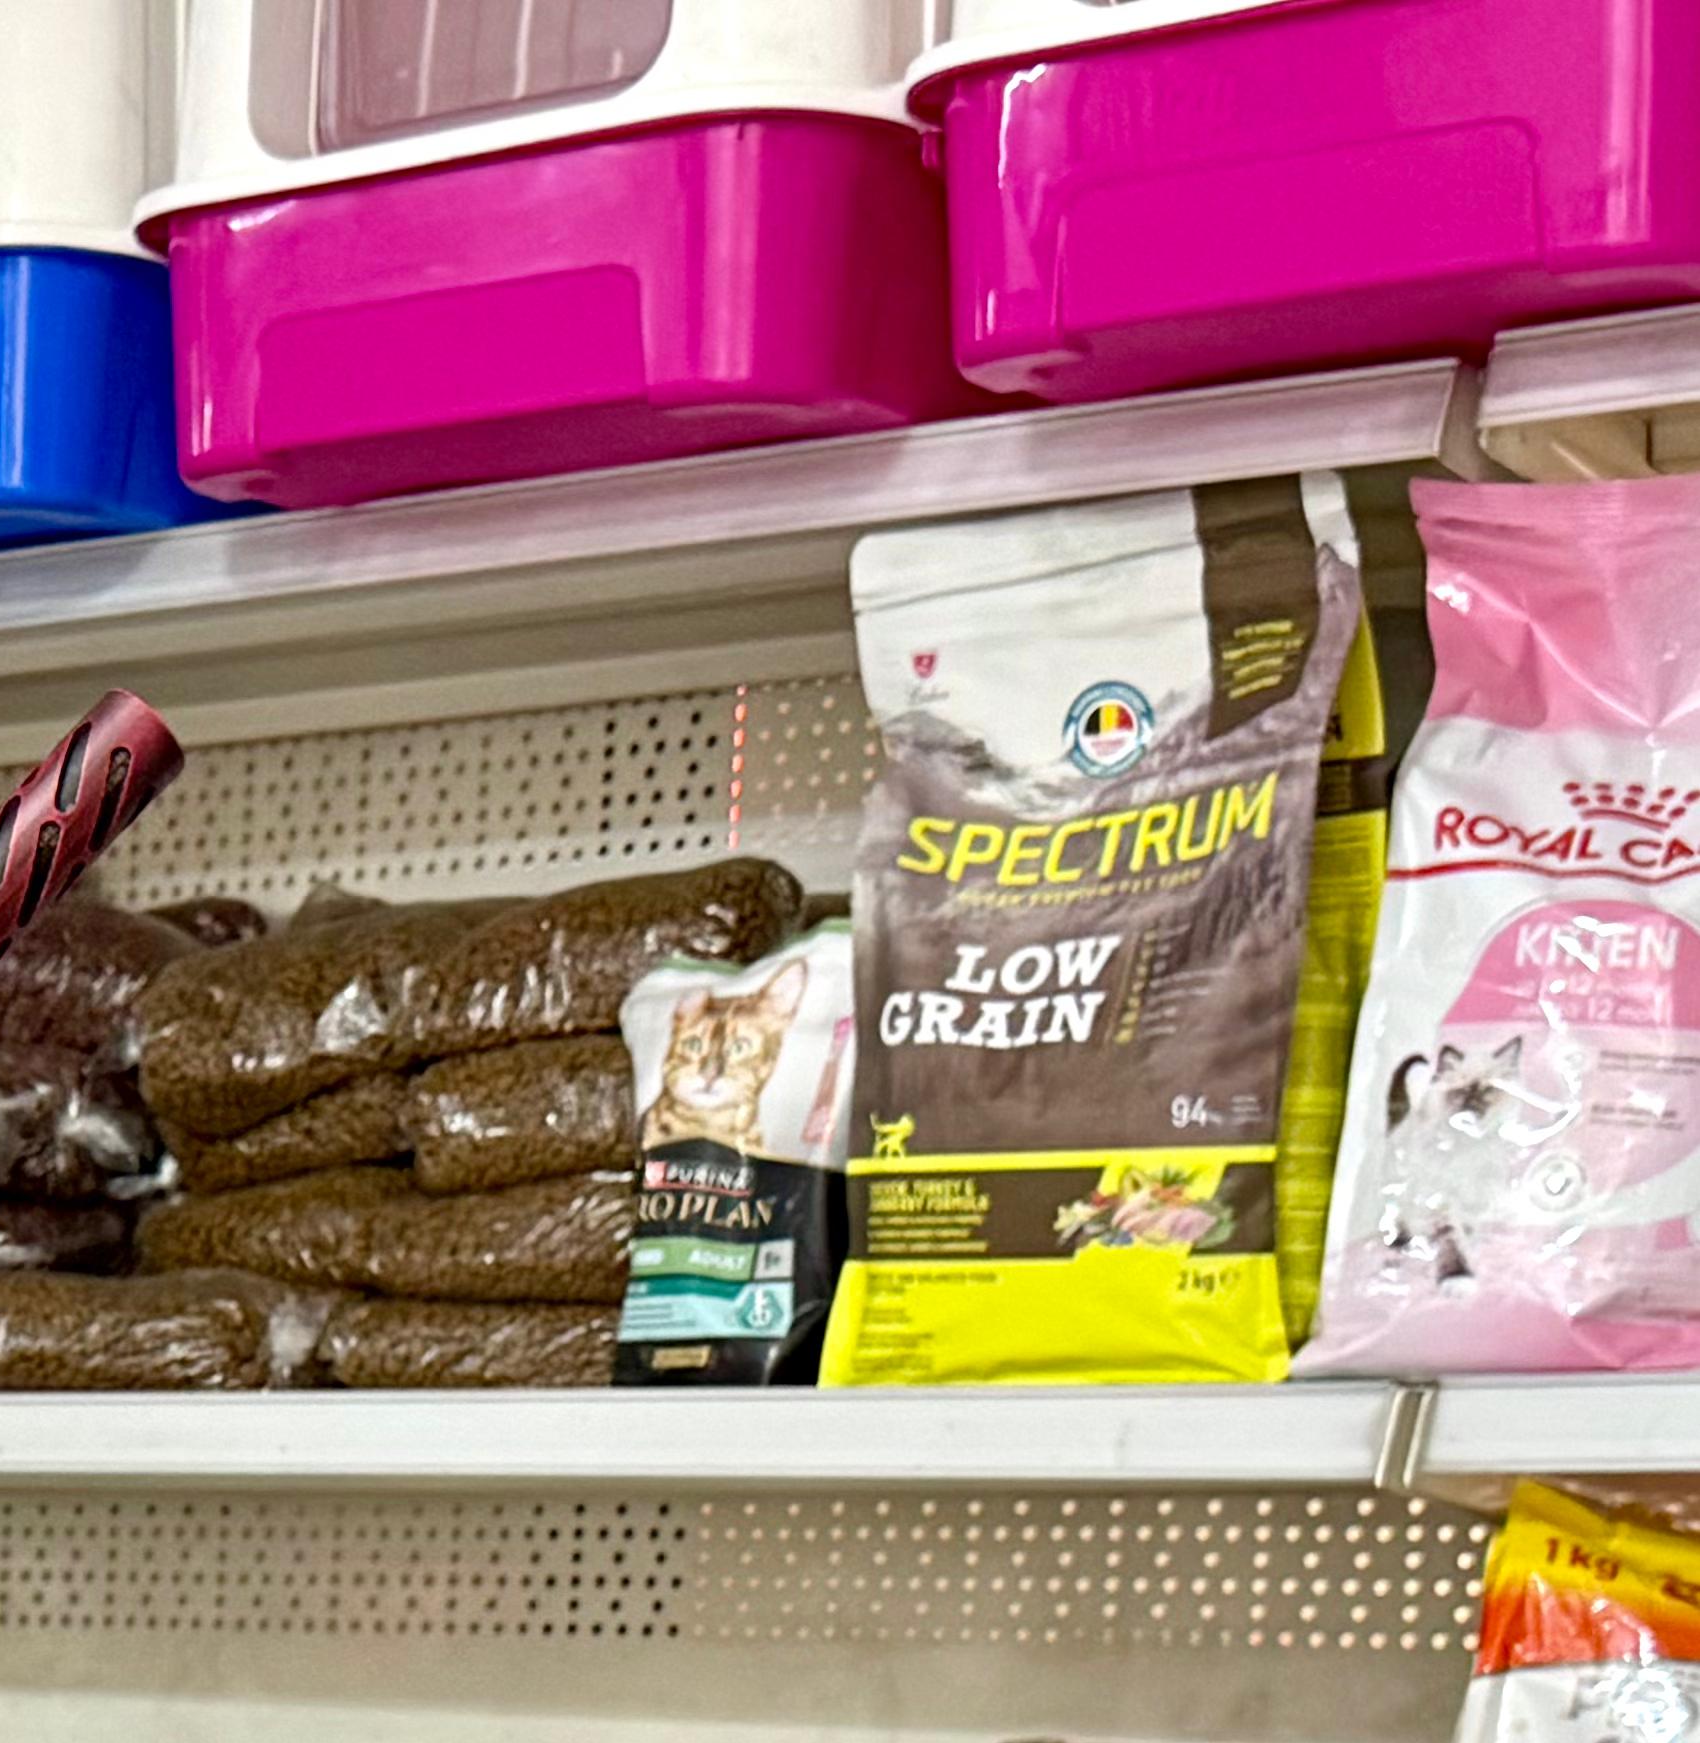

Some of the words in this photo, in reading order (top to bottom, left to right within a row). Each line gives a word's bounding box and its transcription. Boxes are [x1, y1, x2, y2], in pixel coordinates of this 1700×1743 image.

[897, 772, 1277, 886] SPECTRUM
[1434, 806, 1603, 862] ROYAL
[946, 934, 1122, 996] LOW
[879, 990, 1107, 1050] GRAIN
[1545, 1536, 1559, 1565] 1
[1568, 1545, 1620, 1582] kg
